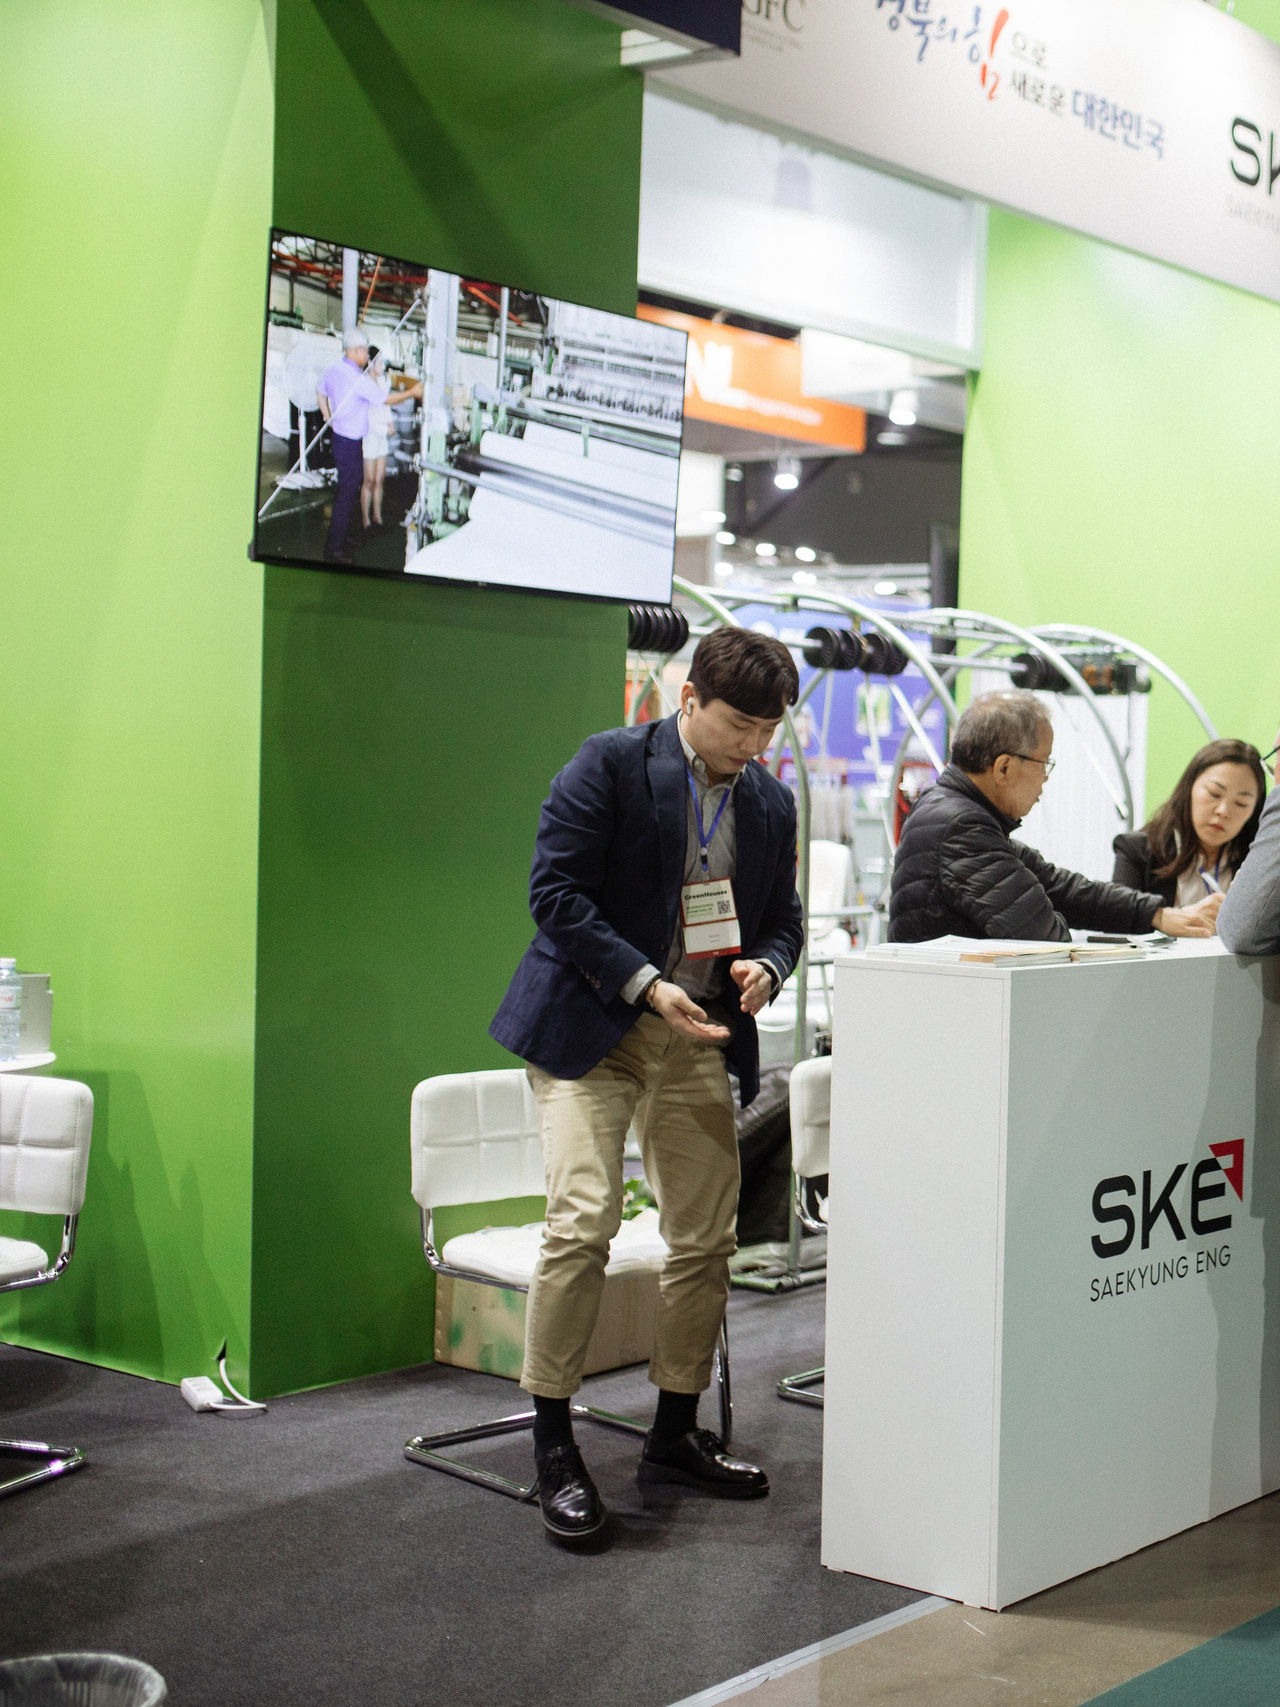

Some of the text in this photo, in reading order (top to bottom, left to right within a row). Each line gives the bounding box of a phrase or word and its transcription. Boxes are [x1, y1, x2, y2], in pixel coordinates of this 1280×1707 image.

[1010, 70, 1165, 160] 새로운 대한민국
[685, 890, 727, 900] GreenHouses
[1091, 1157, 1233, 1259] SKE
[1090, 1245, 1231, 1302] SAEKYUNG ENG
